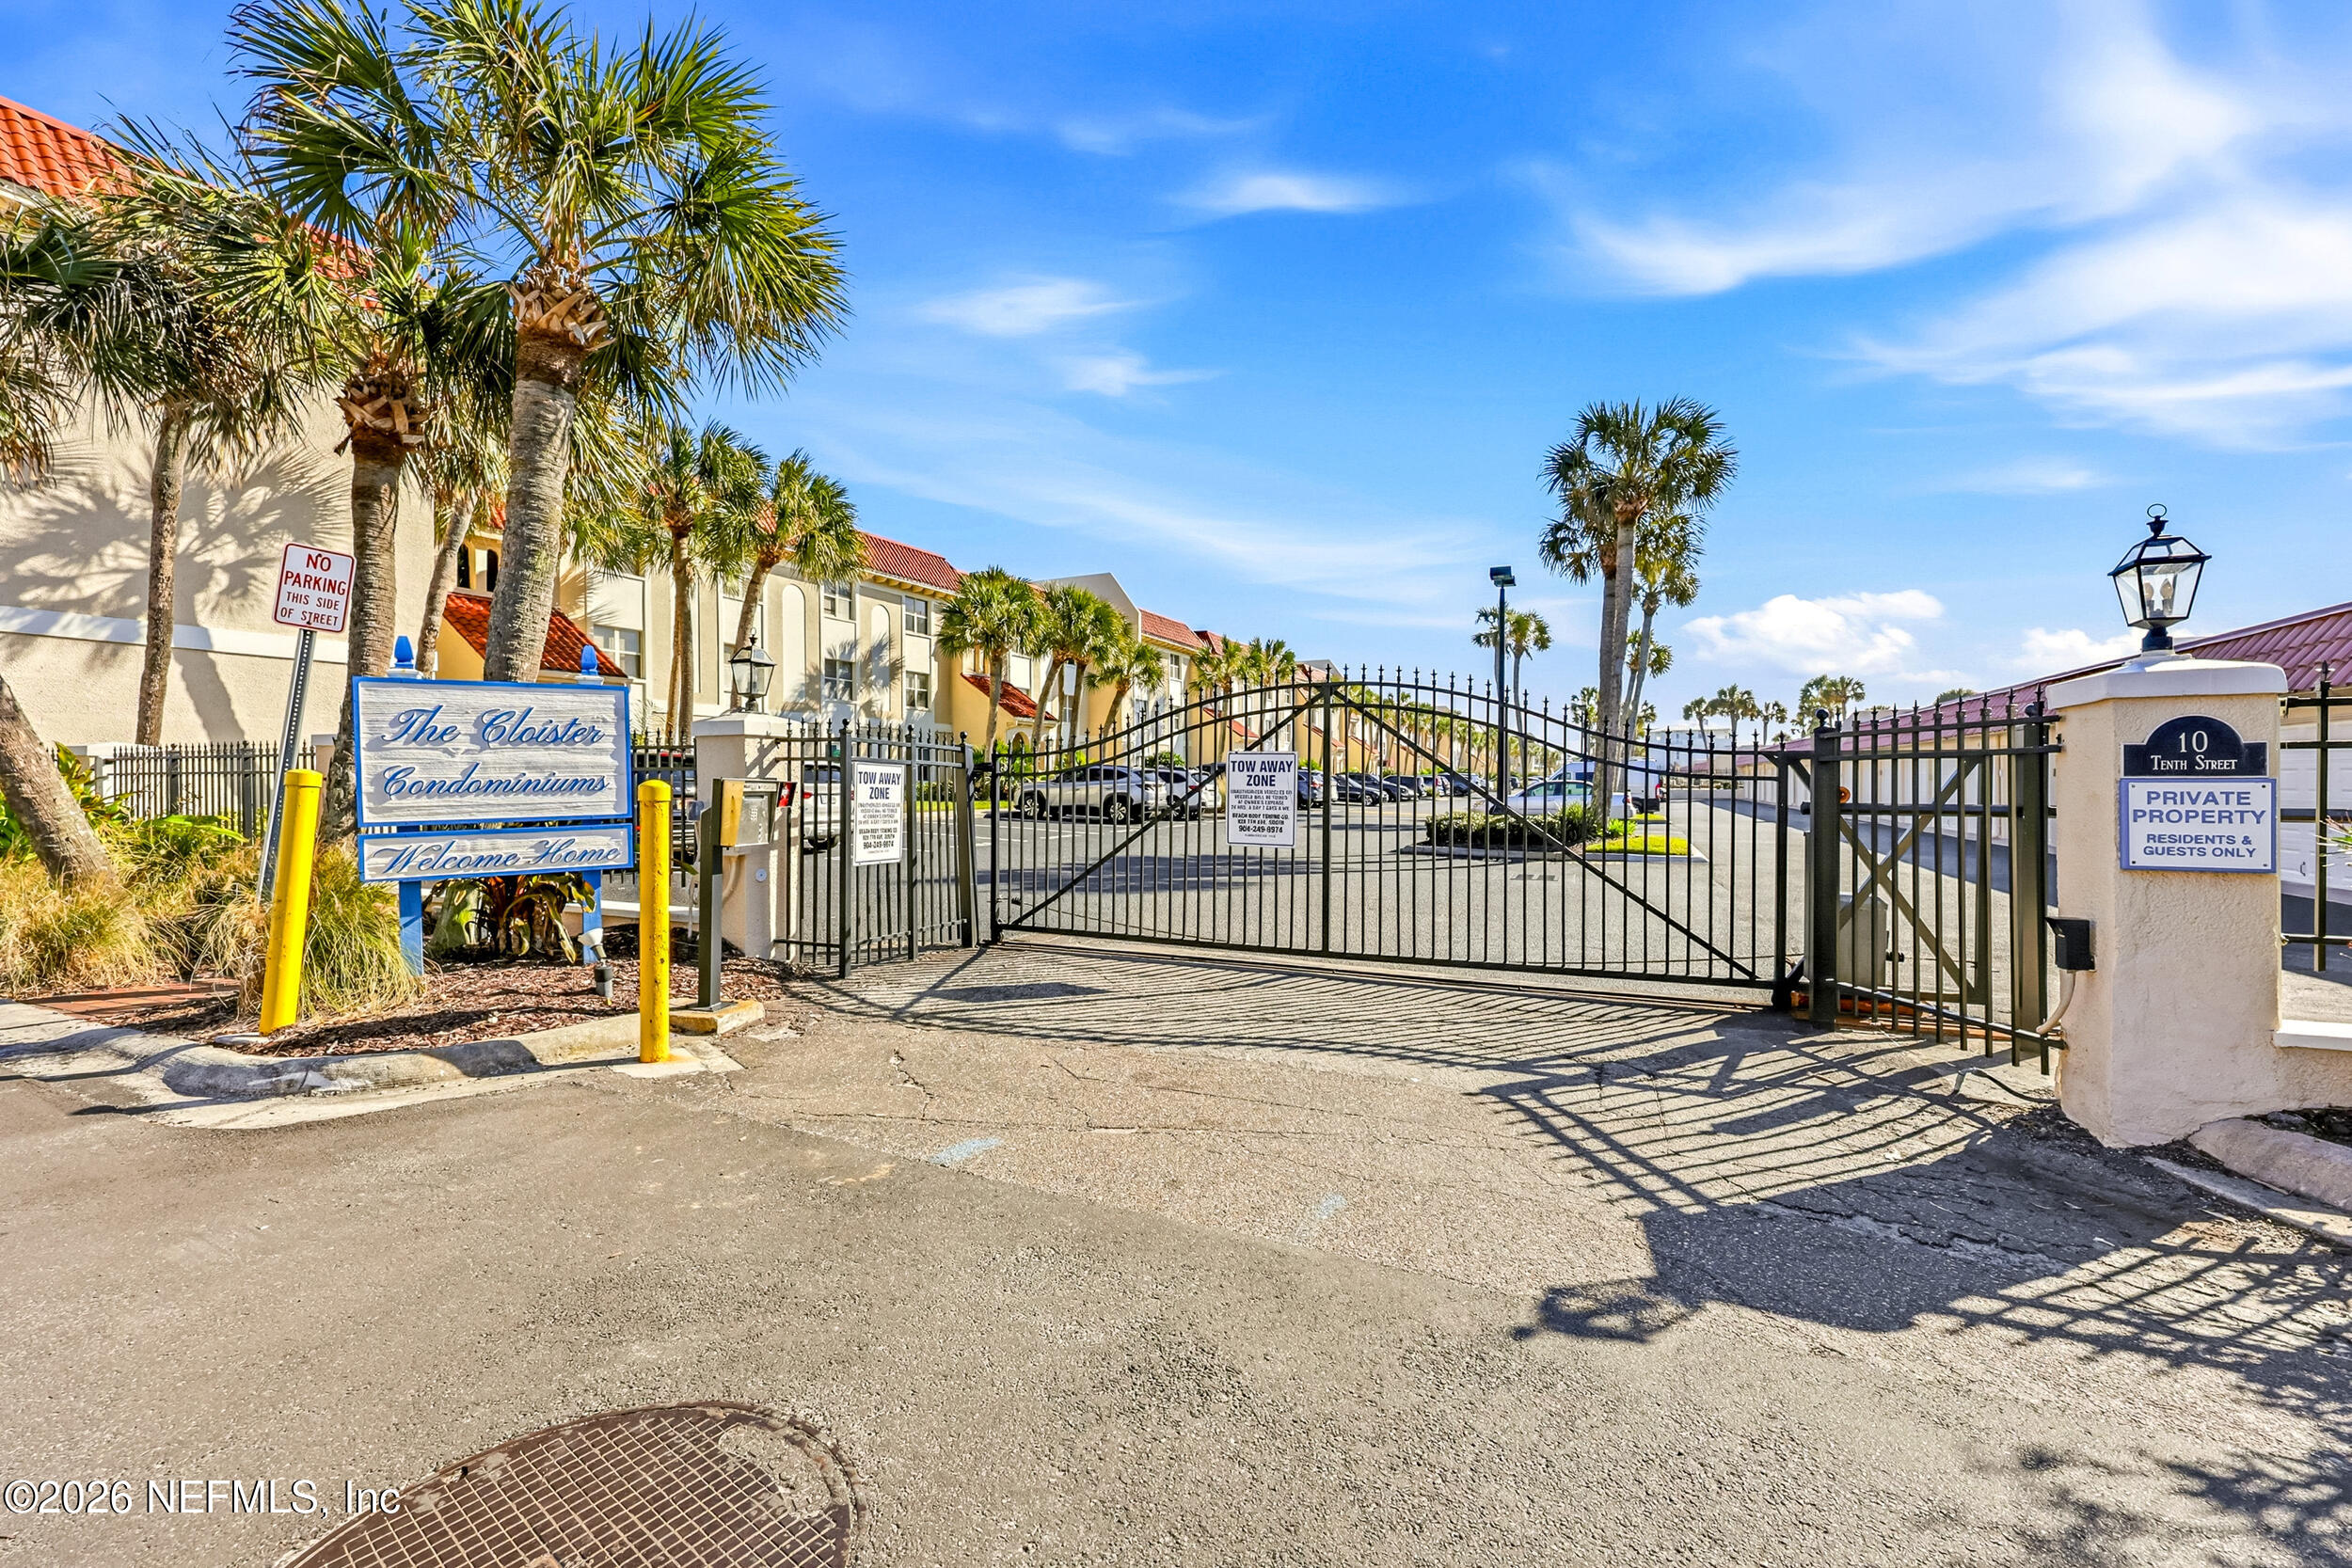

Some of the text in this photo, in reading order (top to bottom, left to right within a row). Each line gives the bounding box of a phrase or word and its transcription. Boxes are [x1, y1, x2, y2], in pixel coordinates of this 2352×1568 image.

[306, 554, 331, 571] NO
[284, 571, 346, 595] PARKING
[286, 591, 340, 610] THIS SIDE
[281, 607, 338, 626] OF STREET
[381, 704, 605, 749] The Cloister
[2179, 731, 2208, 752] 10
[1231, 761, 1293, 772] TOW AWAY
[383, 762, 609, 800] Condominiums
[858, 772, 901, 785] TOW AWAY
[1246, 775, 1276, 786] ZONE
[869, 787, 890, 800] ZONE
[2147, 791, 2251, 806] PRIVATE
[2133, 809, 2266, 824] PROPERTY
[2147, 834, 2252, 845] RESIDENTS &
[373, 838, 620, 874] Welcome Home
[2144, 846, 2256, 858] GUESTS ONLY
